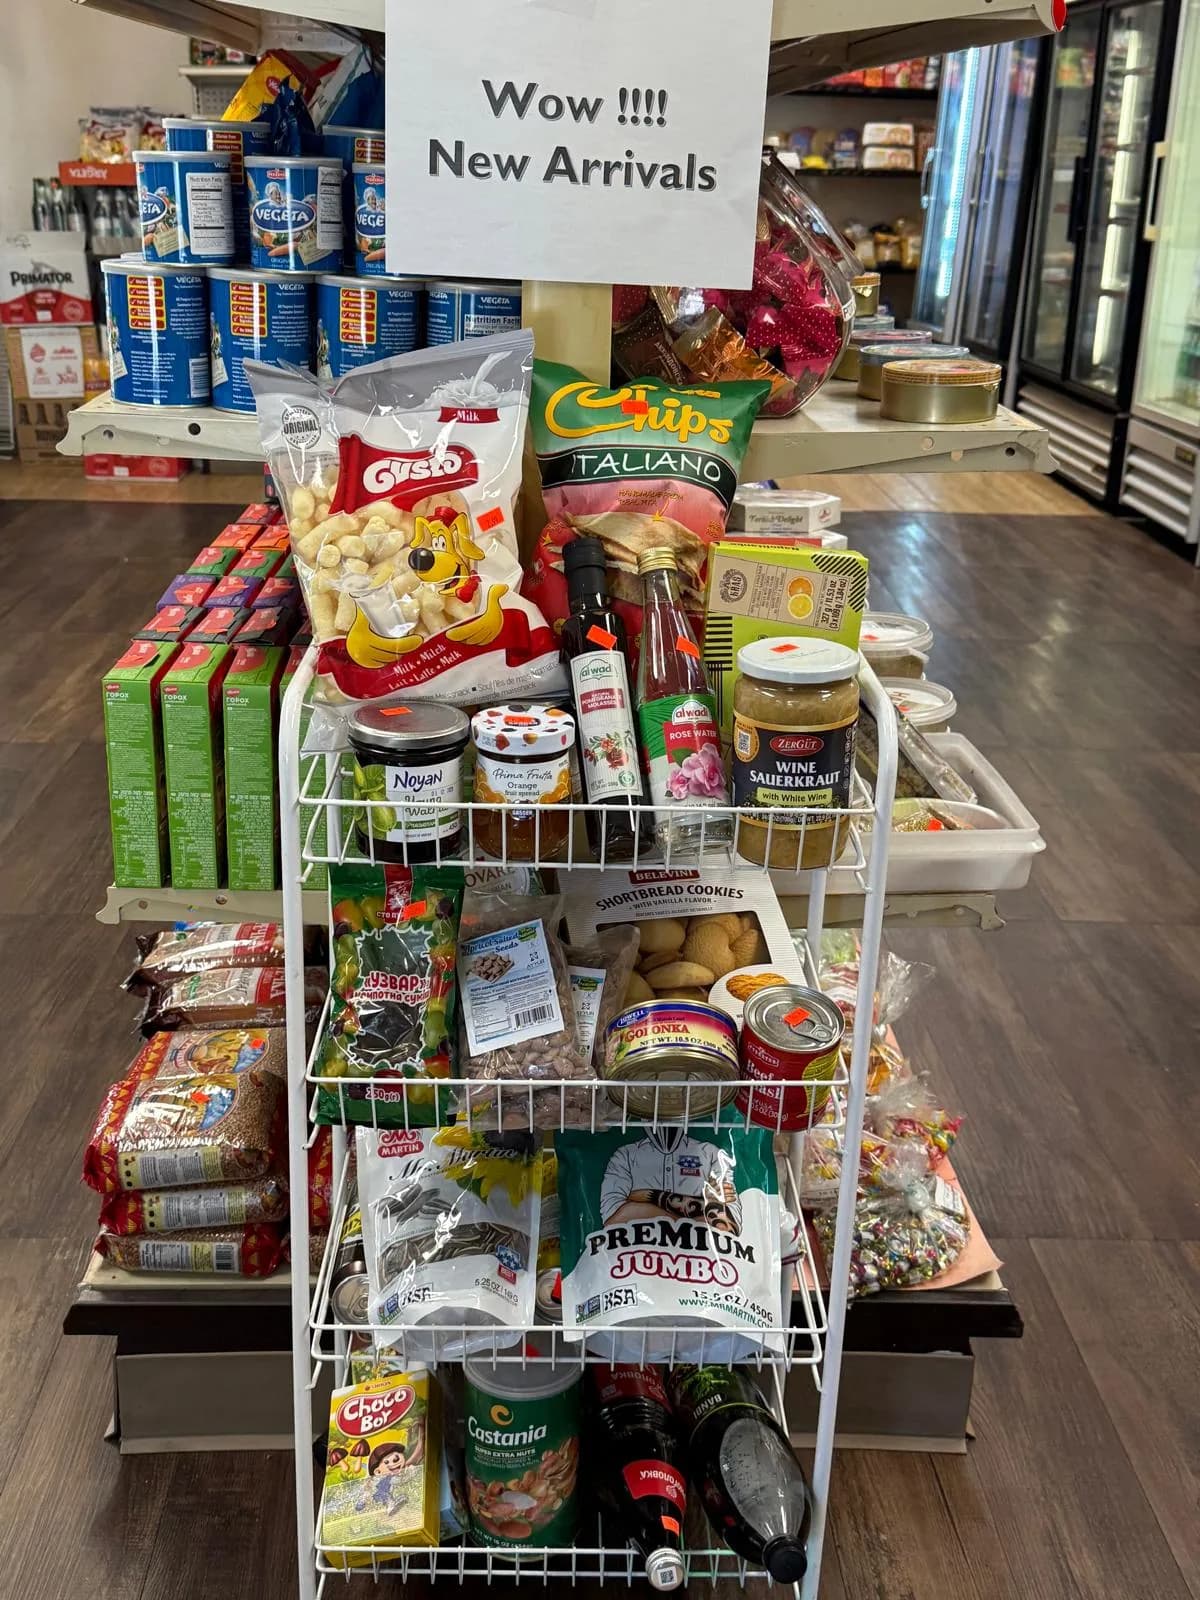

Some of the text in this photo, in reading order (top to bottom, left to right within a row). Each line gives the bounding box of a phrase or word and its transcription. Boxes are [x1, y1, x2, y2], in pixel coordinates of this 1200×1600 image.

[482, 80, 668, 127] Wow !!!!
[429, 139, 718, 191] New Arrivals
[256, 208, 309, 224] VEGETA
[278, 283, 305, 291] VEGETA
[480, 296, 511, 305] VEGETA
[465, 315, 501, 324] Nutrition
[456, 410, 480, 422] Milk
[545, 381, 734, 443] Chips
[283, 419, 318, 435] ORIGINAL
[571, 452, 722, 481] ITALIANO
[821, 612, 830, 624] 327
[393, 643, 447, 677] Milk Milch
[440, 650, 462, 668] Melk
[670, 728, 717, 740] ROSE WATER
[775, 761, 817, 774] WINE
[393, 769, 443, 792] Noyan
[508, 781, 538, 791] Orange
[749, 769, 841, 788] SAUERKRAUT
[518, 790, 540, 798] spread
[762, 791, 827, 803] with White Wine
[595, 885, 745, 911] SHORTBREAD COOKIES
[633, 900, 652, 910] WITH
[653, 898, 683, 907] VANILLA
[495, 941, 519, 954] Seeds
[747, 1060, 775, 1081] Beef
[381, 1143, 420, 1155] MARTIN
[588, 1220, 756, 1264] PREMIUM
[611, 1250, 739, 1287] JUMBO
[491, 1281, 501, 1291] OZ
[604, 1287, 636, 1311] KSA
[724, 1292, 742, 1304] OZ
[750, 1303, 774, 1322] 450G
[343, 1388, 408, 1421] Choco
[468, 1415, 548, 1446] Castania
[474, 1445, 492, 1455] SUPER
[515, 1448, 536, 1456] NUTS
